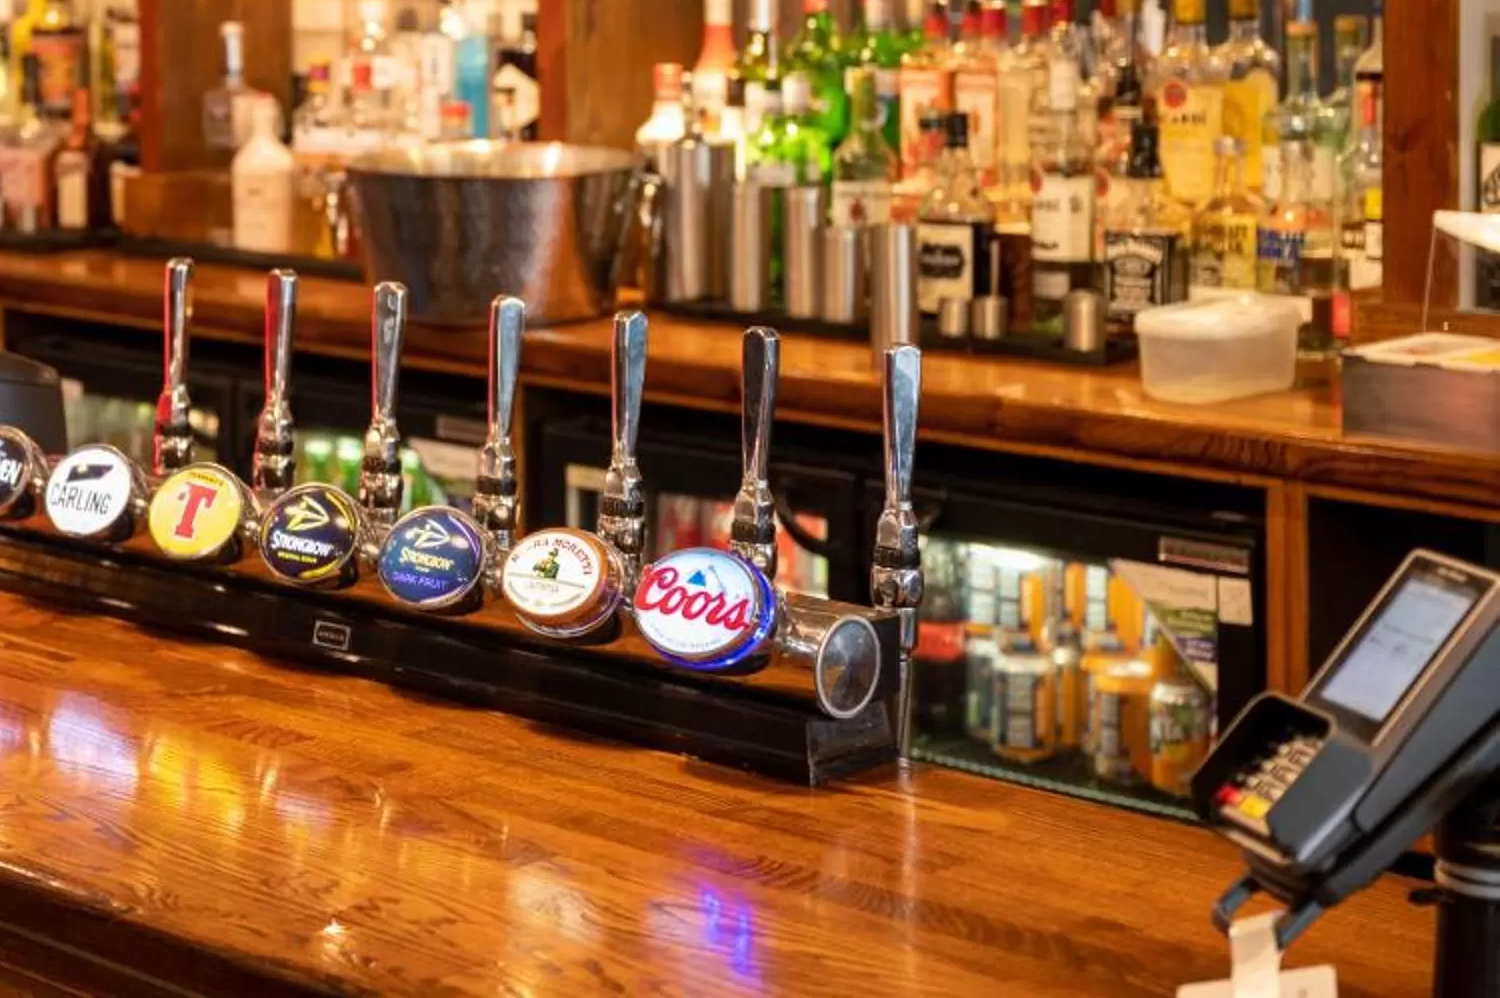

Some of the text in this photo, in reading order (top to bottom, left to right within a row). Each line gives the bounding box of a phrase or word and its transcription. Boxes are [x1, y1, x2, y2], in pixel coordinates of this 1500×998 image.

[51, 482, 113, 515] CARLING
[174, 481, 218, 539] T
[270, 528, 335, 558] STRONGBOW
[553, 537, 593, 576] MORETTI
[633, 563, 753, 632] Coors
